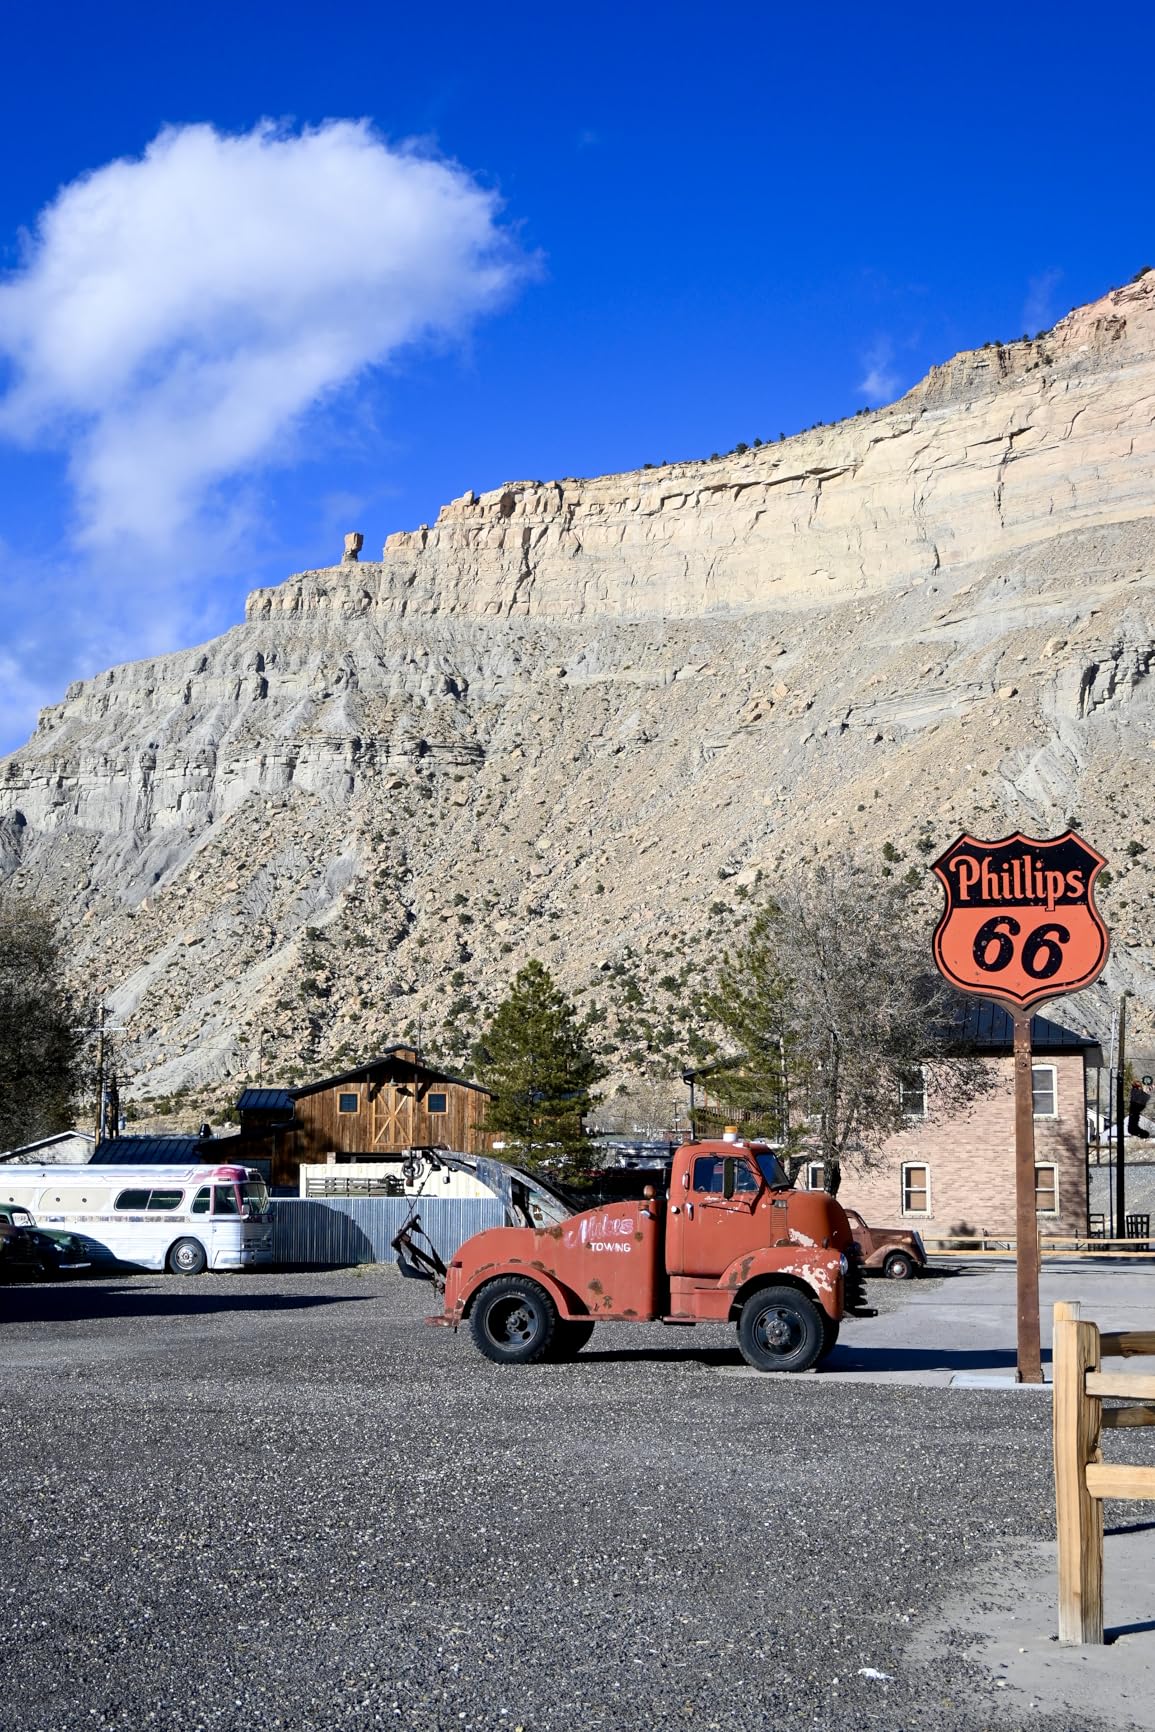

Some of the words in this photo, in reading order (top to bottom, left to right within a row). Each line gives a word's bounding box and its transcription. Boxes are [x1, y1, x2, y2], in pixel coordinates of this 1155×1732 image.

[949, 854, 1086, 912] Phillips
[972, 915, 1071, 980] 66
[590, 1242, 632, 1253] TOWING
